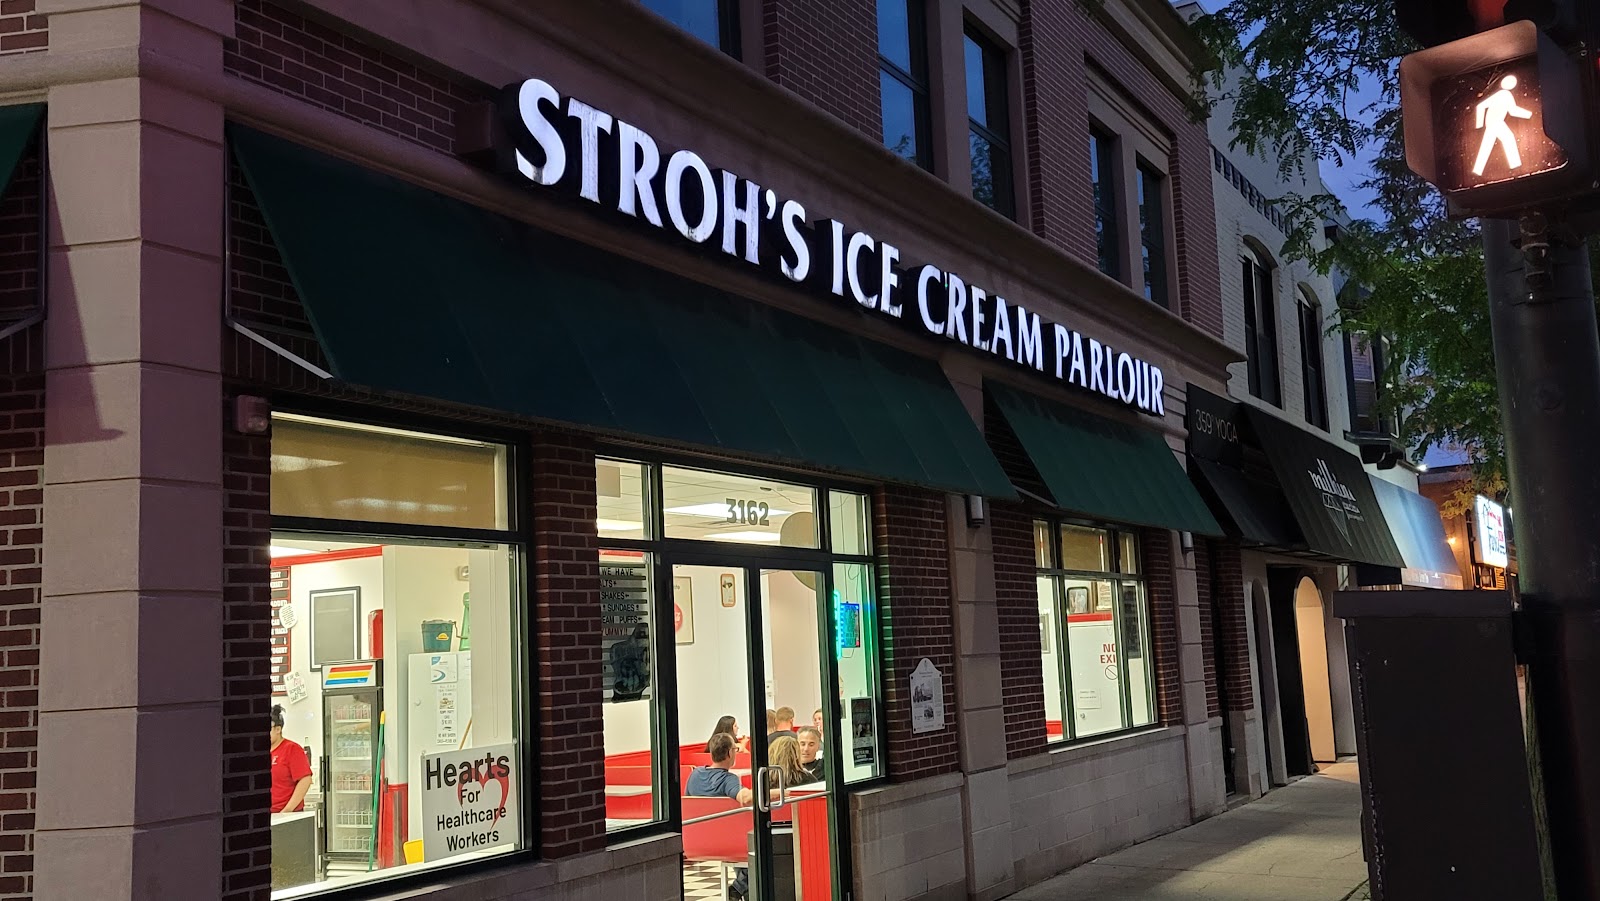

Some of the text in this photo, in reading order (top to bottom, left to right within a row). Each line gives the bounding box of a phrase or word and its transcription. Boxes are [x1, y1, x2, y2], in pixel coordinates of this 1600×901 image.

[515, 78, 1166, 417] STROH'S ICE CREAM PARLOUR
[1215, 416, 1239, 445] YOGA
[725, 498, 770, 527] 3162
[601, 567, 634, 576] WE HAVE
[426, 752, 510, 791] Hearts
[460, 788, 481, 806] For
[437, 806, 507, 831] Healthcare
[446, 830, 500, 852] Workers
